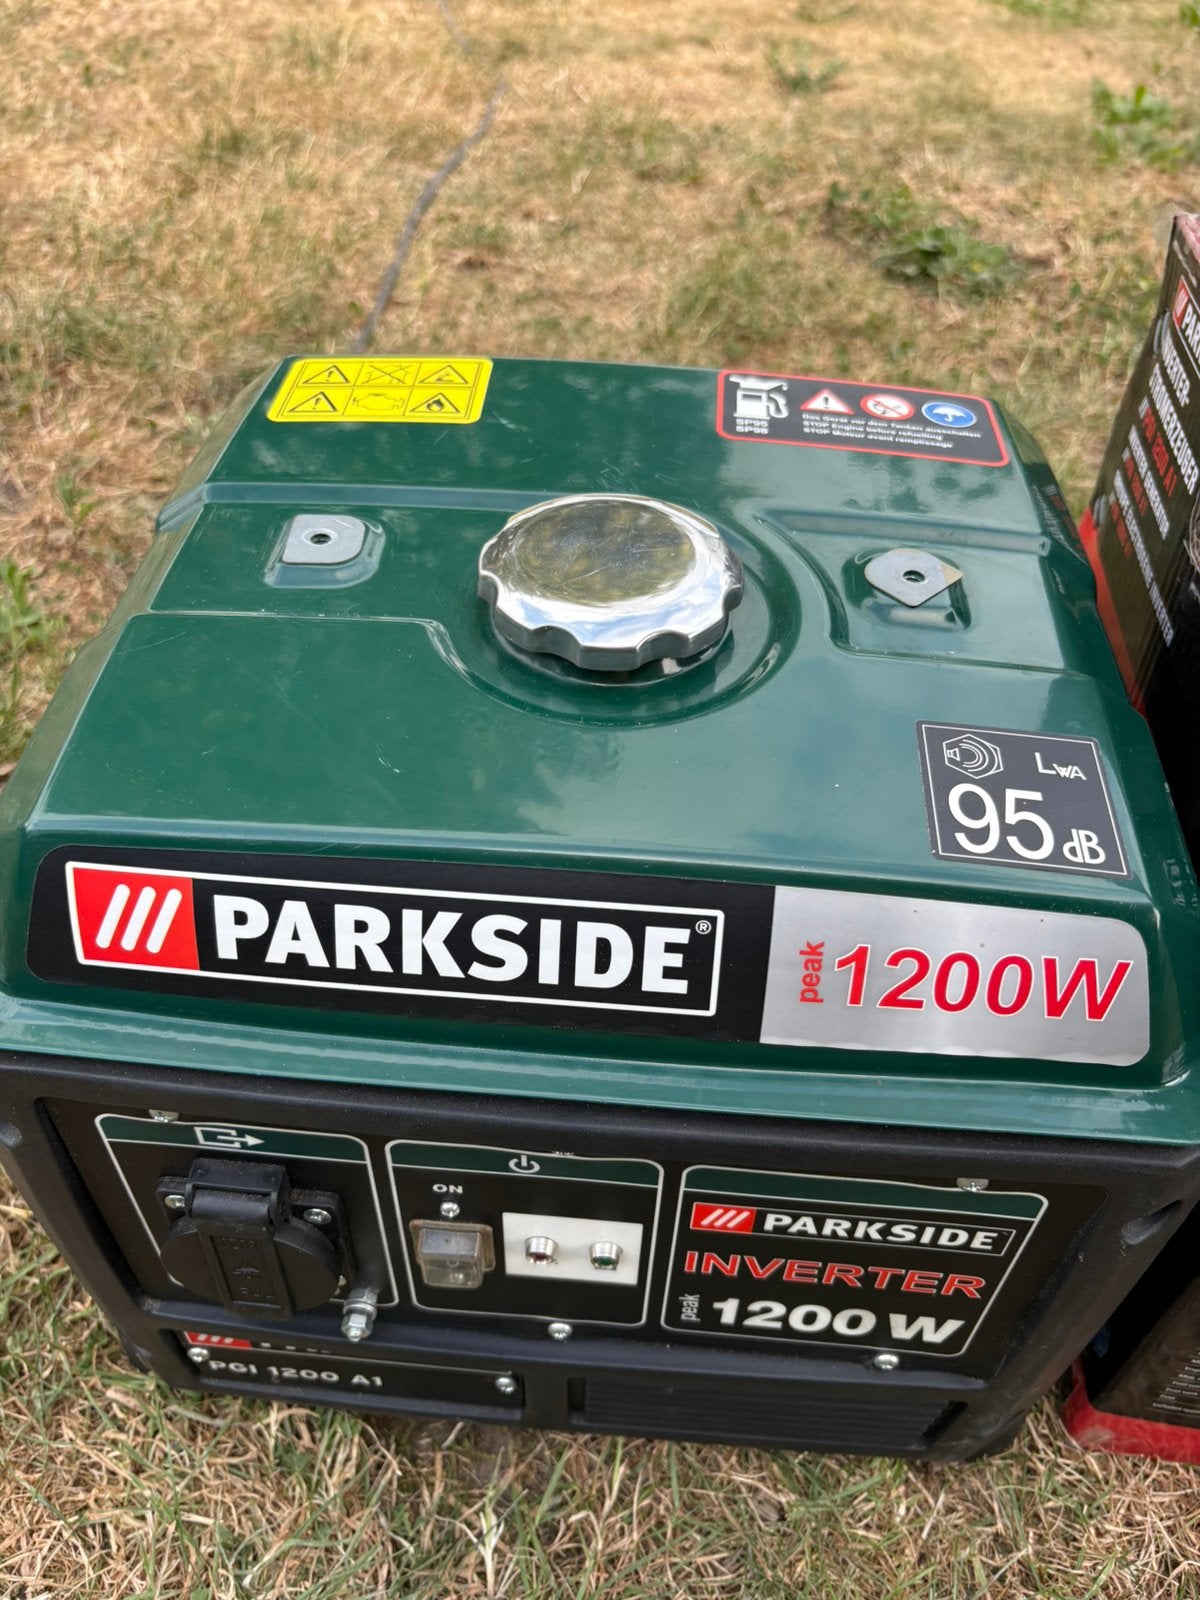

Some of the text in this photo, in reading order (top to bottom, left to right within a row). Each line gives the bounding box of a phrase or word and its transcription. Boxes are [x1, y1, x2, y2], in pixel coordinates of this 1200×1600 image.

[1182, 302, 1200, 366] PAR
[803, 427, 830, 435] STOP
[1149, 362, 1198, 495] STROMERZEUGER
[948, 783, 1106, 865] 95 dB
[799, 940, 1134, 1021] peak 1200W
[432, 1183, 464, 1194] ON
[763, 1213, 999, 1250] PARKSIDE
[684, 1250, 986, 1299] INVERTER
[680, 1293, 966, 1344] peak 1200 W
[208, 1360, 384, 1387] PGI 1200 A1
